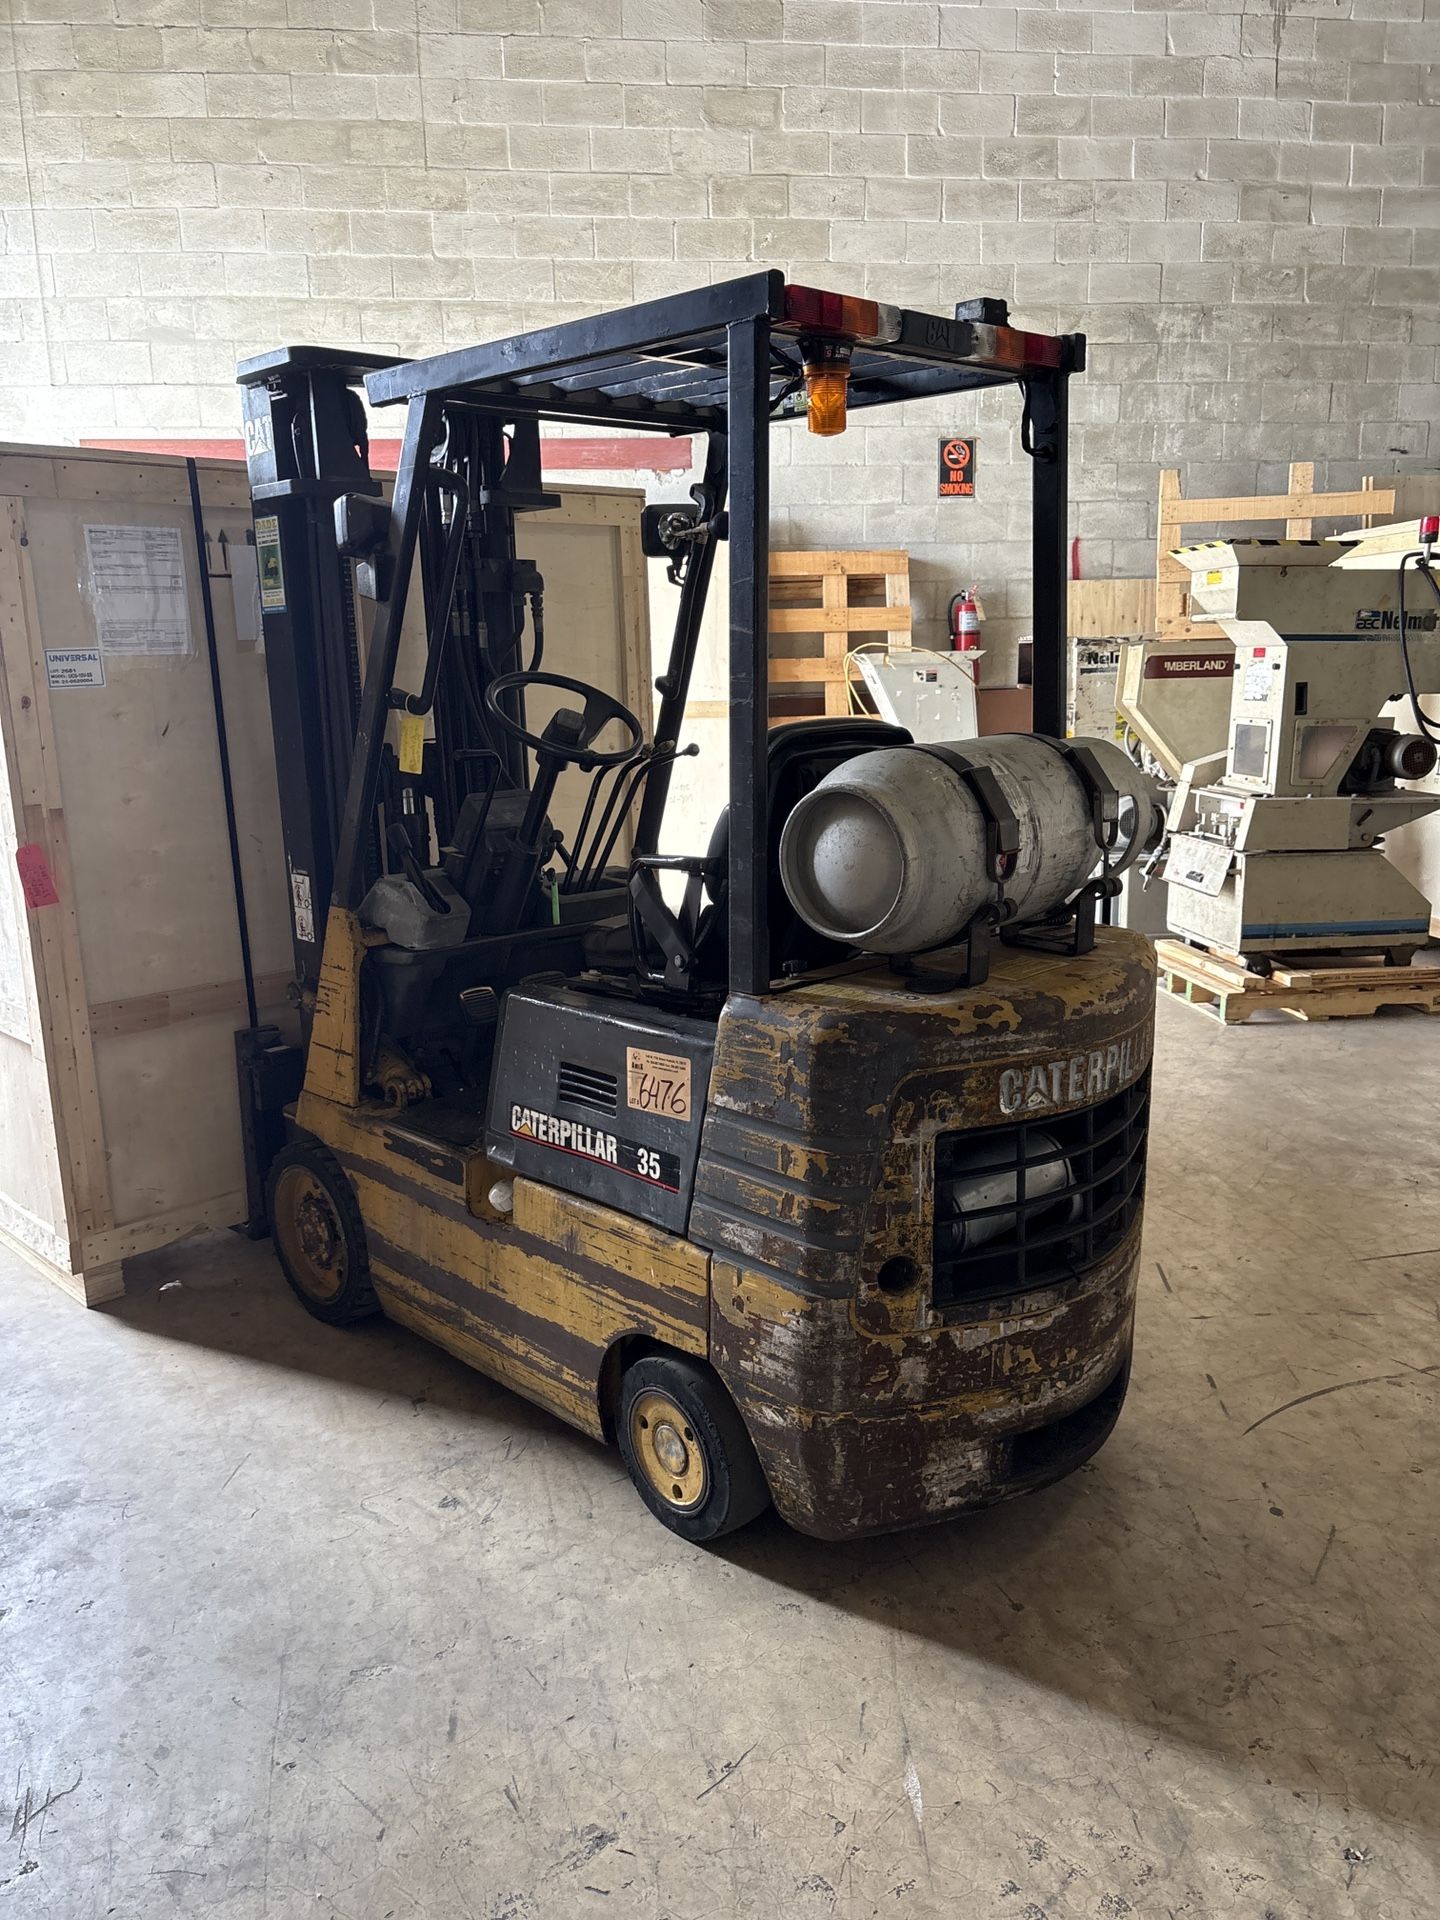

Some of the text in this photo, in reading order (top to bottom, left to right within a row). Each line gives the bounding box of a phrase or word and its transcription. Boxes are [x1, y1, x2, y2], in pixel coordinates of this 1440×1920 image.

[245, 415, 272, 457] CAT
[950, 470, 964, 482] NO
[940, 483, 974, 495] SMOKING
[49, 654, 98, 662] UNIVERSAL
[1087, 651, 1120, 664] Nel
[639, 1073, 687, 1114] 6476
[511, 1105, 661, 1180] CATERPILLAR 35
